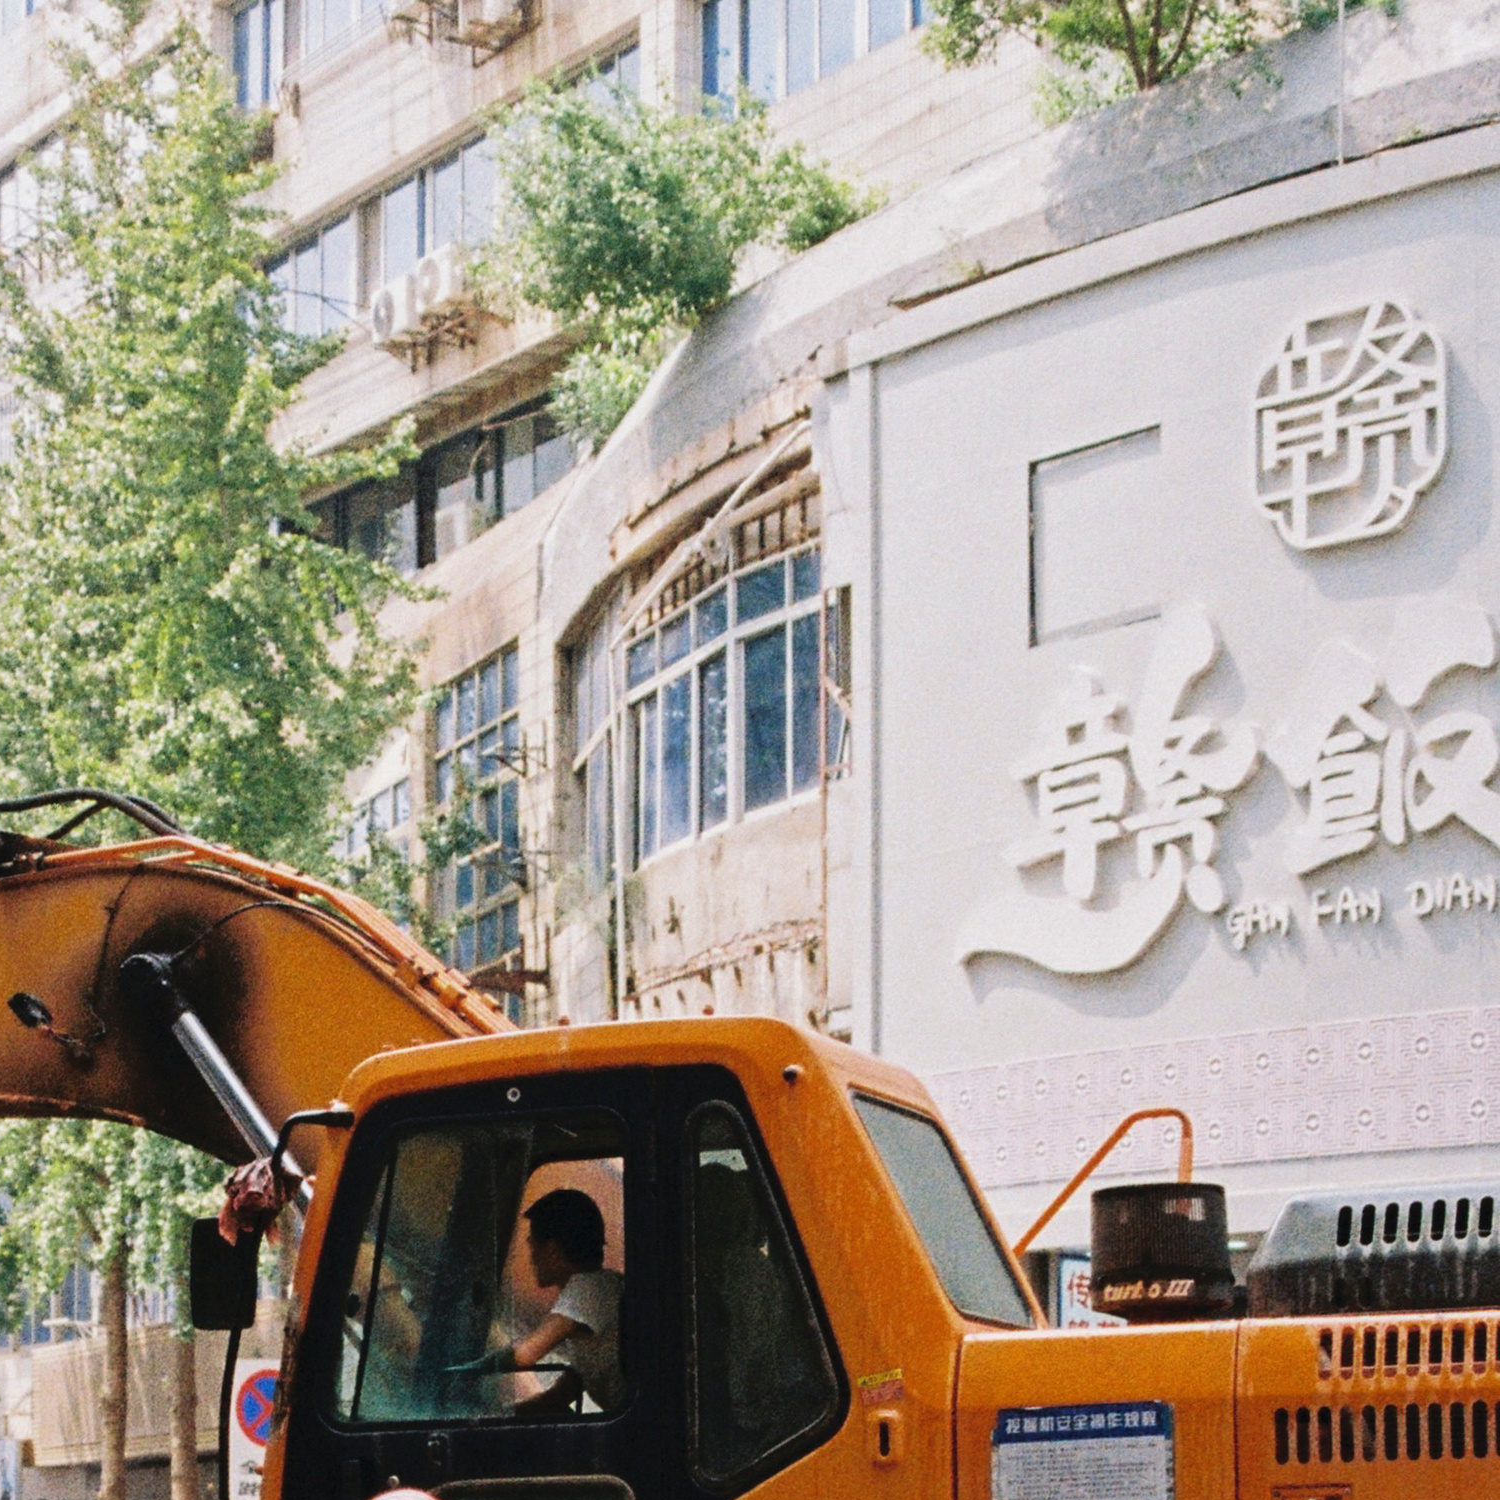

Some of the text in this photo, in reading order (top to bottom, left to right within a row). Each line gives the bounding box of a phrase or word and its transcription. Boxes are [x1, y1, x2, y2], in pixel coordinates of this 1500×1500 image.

[1311, 886, 1383, 926] FAN
[1404, 872, 1498, 916] DIAN
[1163, 1278, 1195, 1297] III
